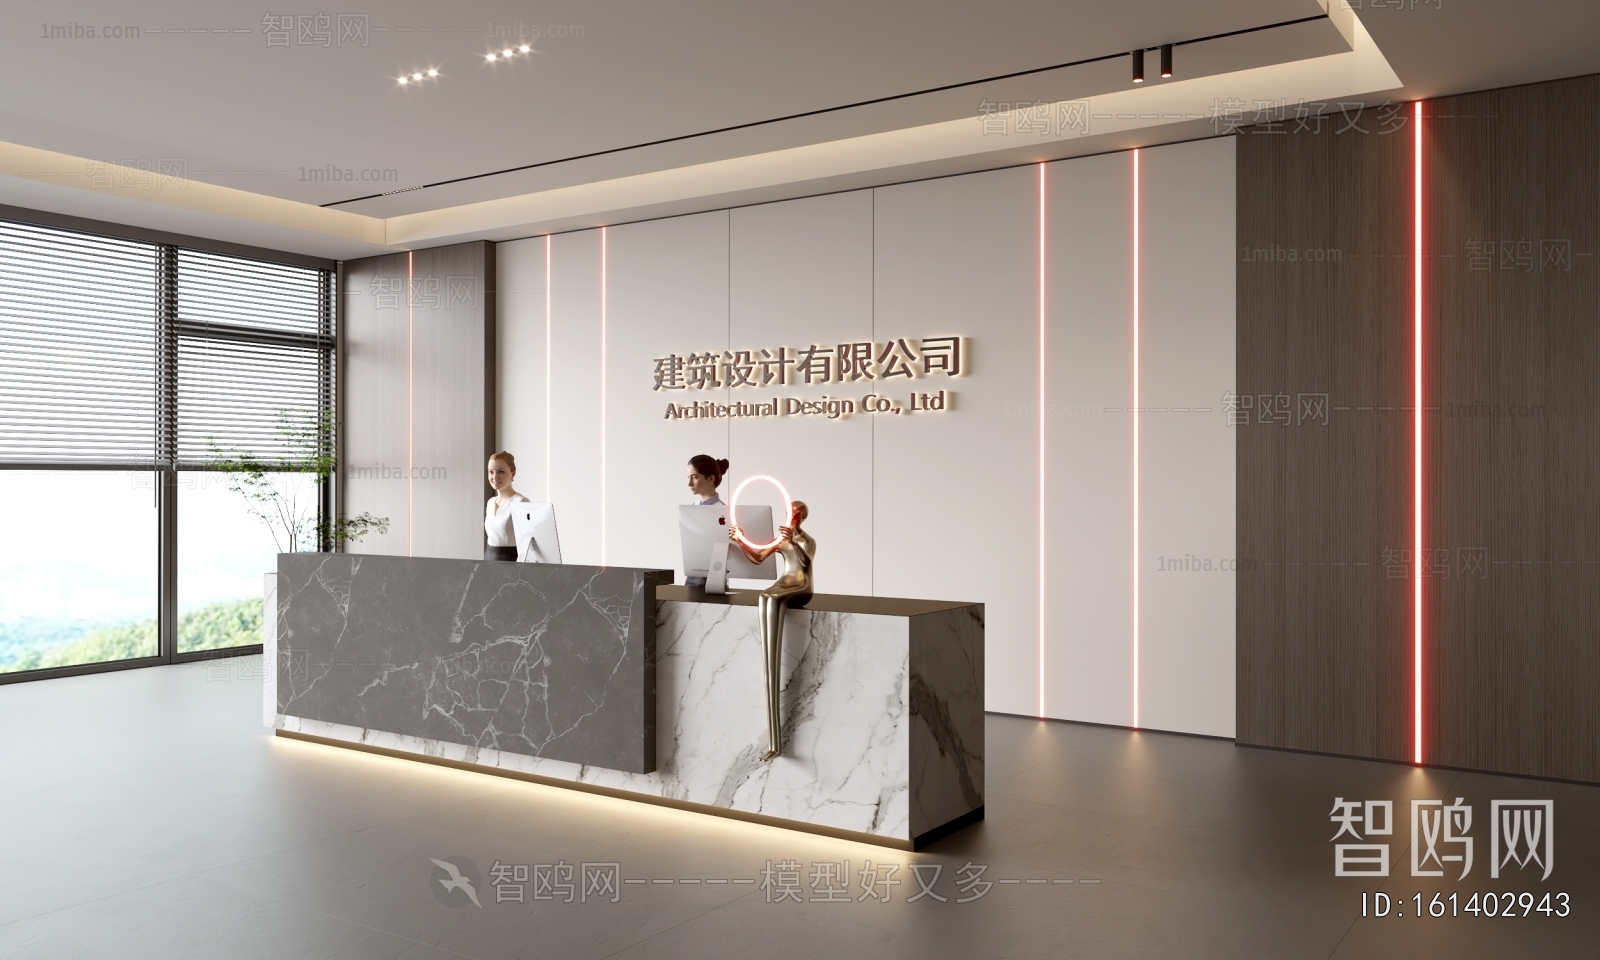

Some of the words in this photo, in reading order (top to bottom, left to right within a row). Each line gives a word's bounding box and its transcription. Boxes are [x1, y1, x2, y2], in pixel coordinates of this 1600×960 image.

[652, 335, 962, 393] 建筑设计有限公司
[664, 397, 778, 420] Architectural
[786, 395, 853, 419] Design
[861, 393, 901, 415] Co.,
[910, 390, 945, 411] Ltd
